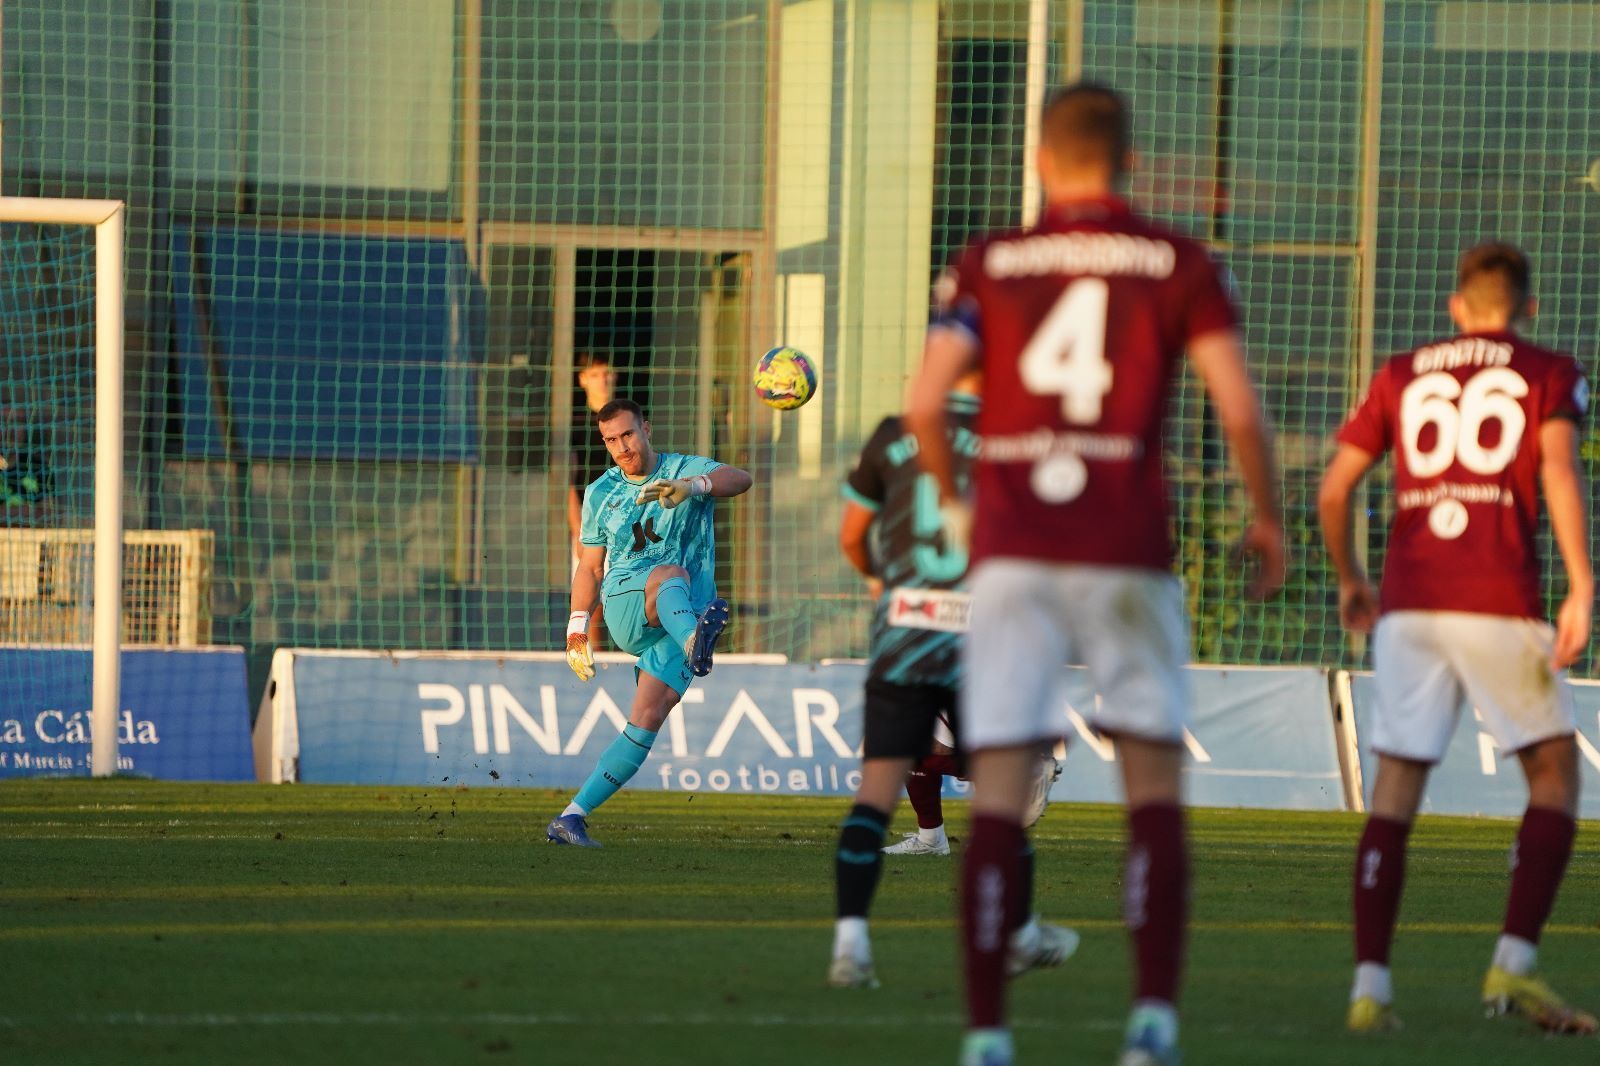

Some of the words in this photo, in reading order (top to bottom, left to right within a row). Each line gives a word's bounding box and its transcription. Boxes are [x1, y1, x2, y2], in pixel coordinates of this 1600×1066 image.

[1018, 276, 1113, 425] 4
[1400, 367, 1529, 477] 66
[0, 719, 26, 744] a
[35, 709, 160, 744] Cálda
[418, 683, 854, 759] PINATAR
